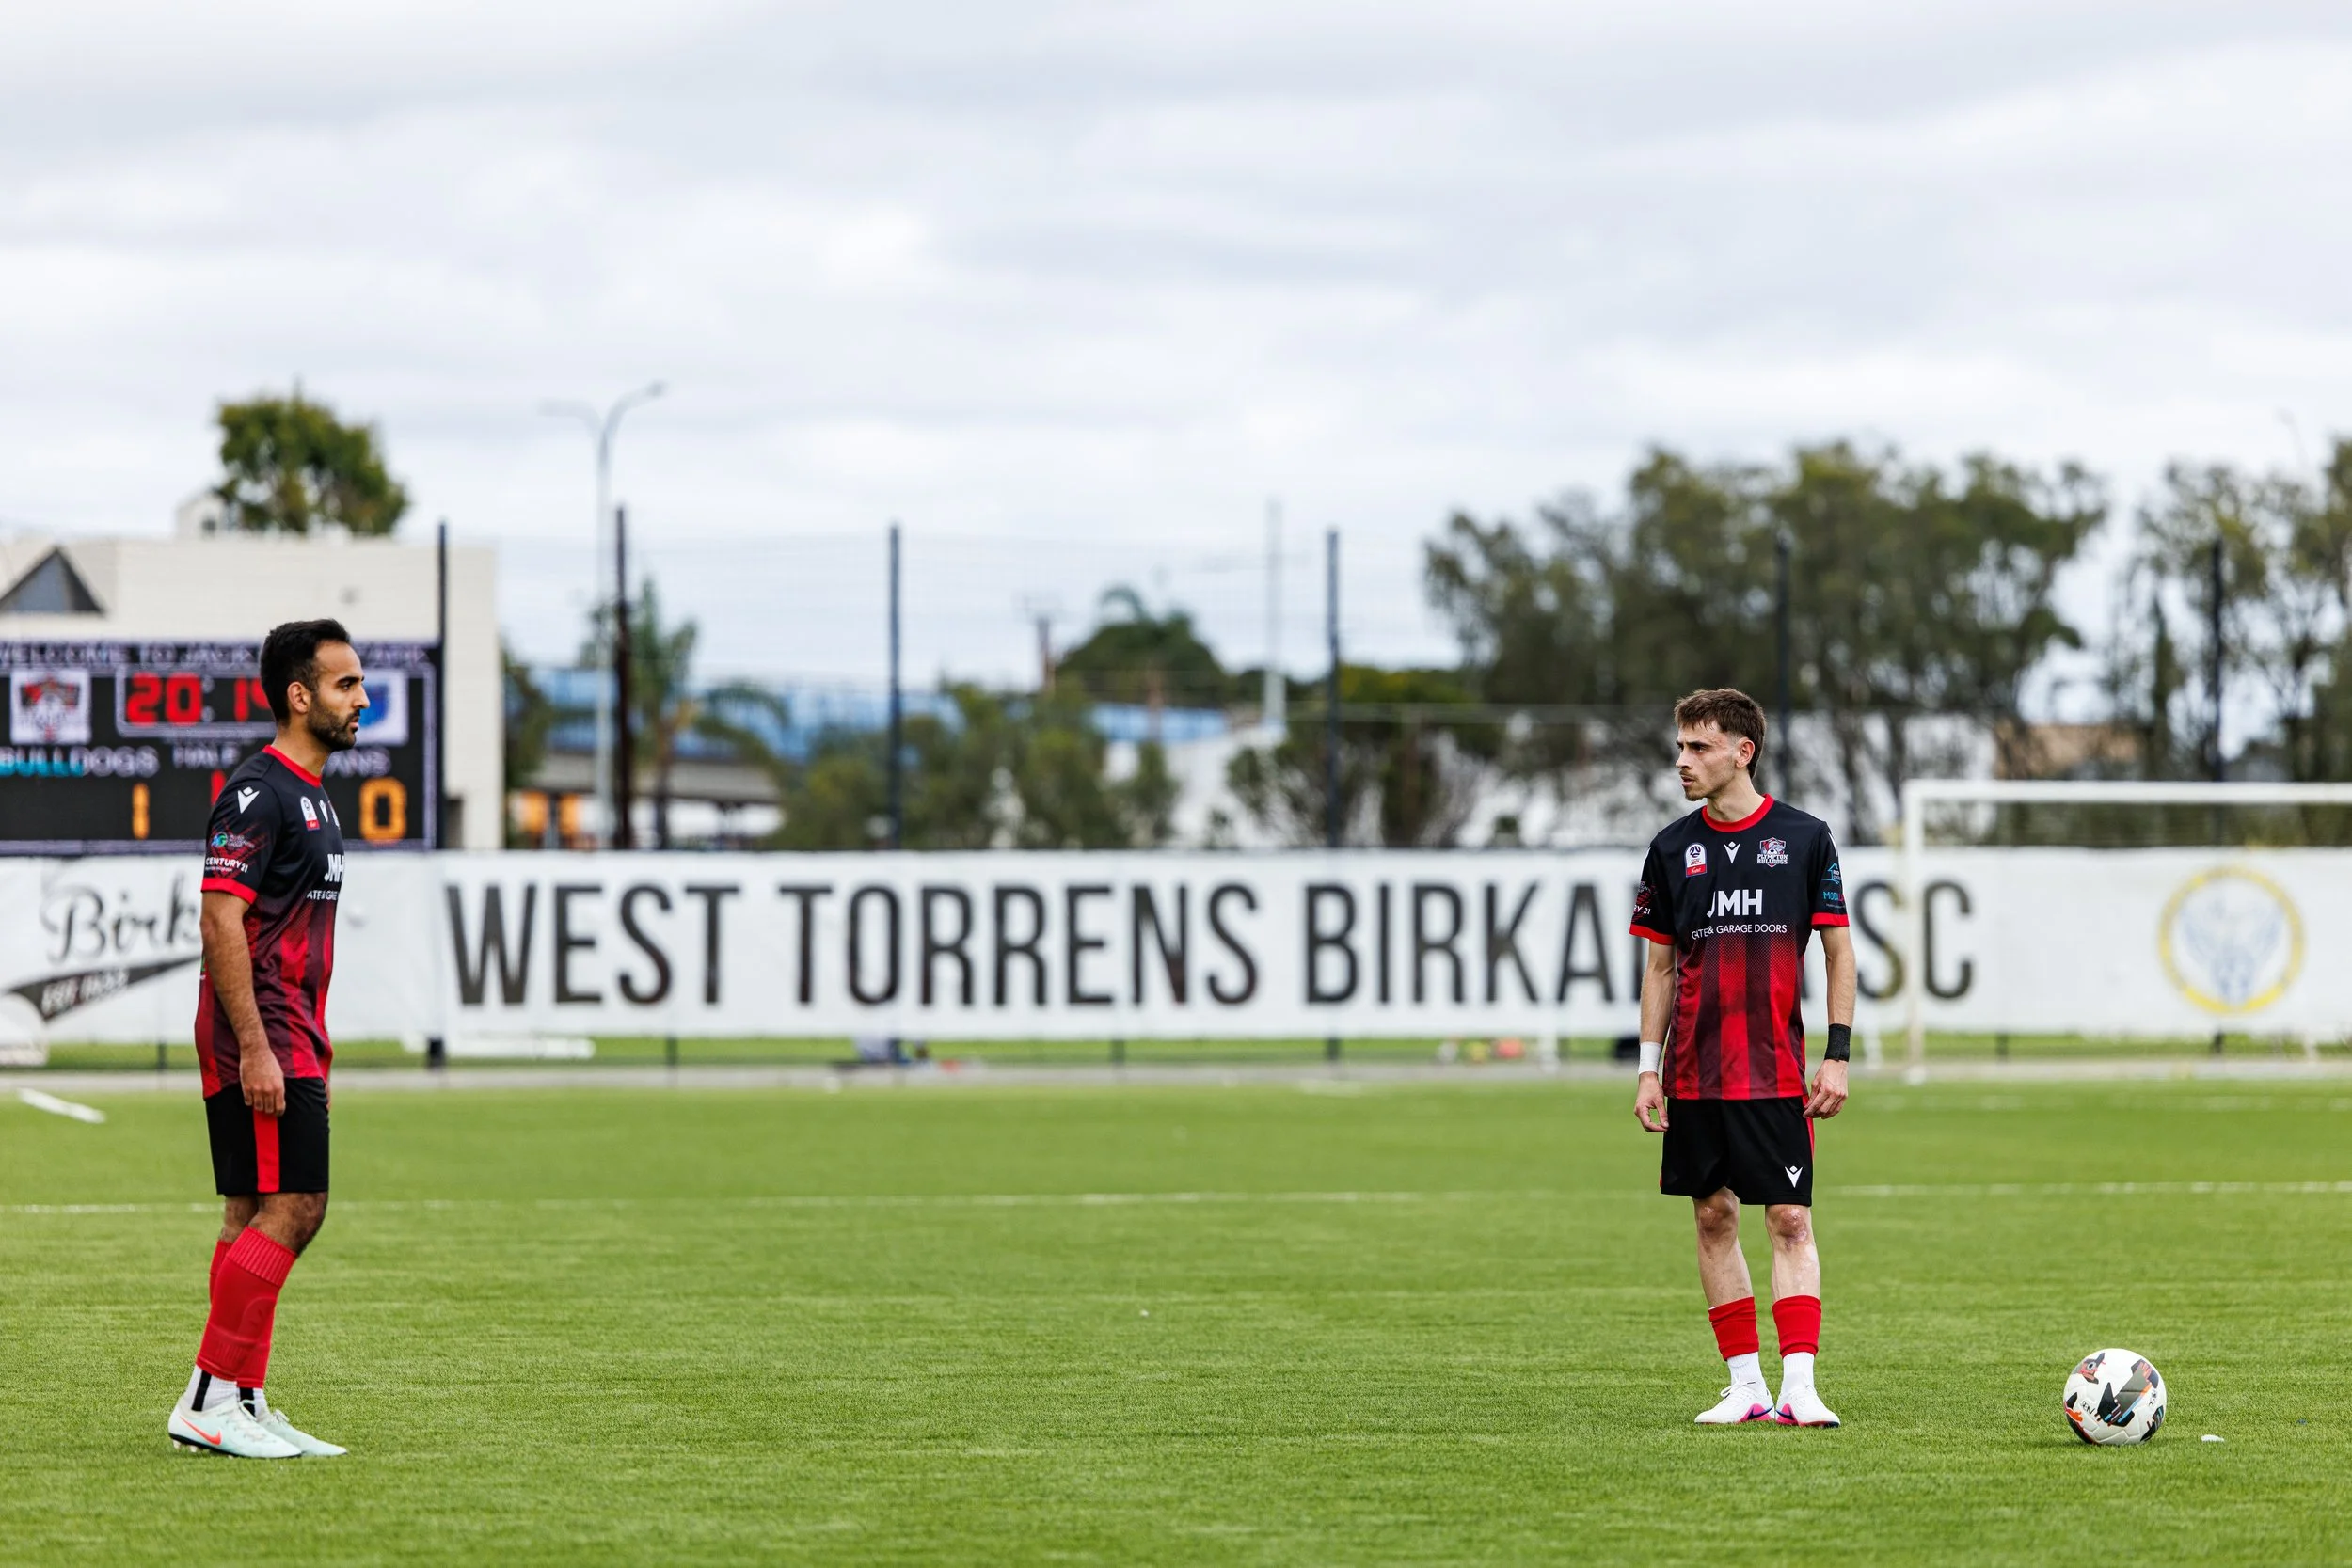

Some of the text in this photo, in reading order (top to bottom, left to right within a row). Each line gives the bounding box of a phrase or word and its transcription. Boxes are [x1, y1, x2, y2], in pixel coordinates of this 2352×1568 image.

[358, 777, 407, 843] 0
[205, 857, 242, 868] CENTURY
[1706, 889, 1763, 918] JMH
[446, 883, 739, 1005] WEST
[779, 883, 1259, 1005] TORRENS
[1708, 926, 1714, 935] &
[1716, 924, 1753, 934] GARAGE
[1754, 924, 1788, 933] DOORS
